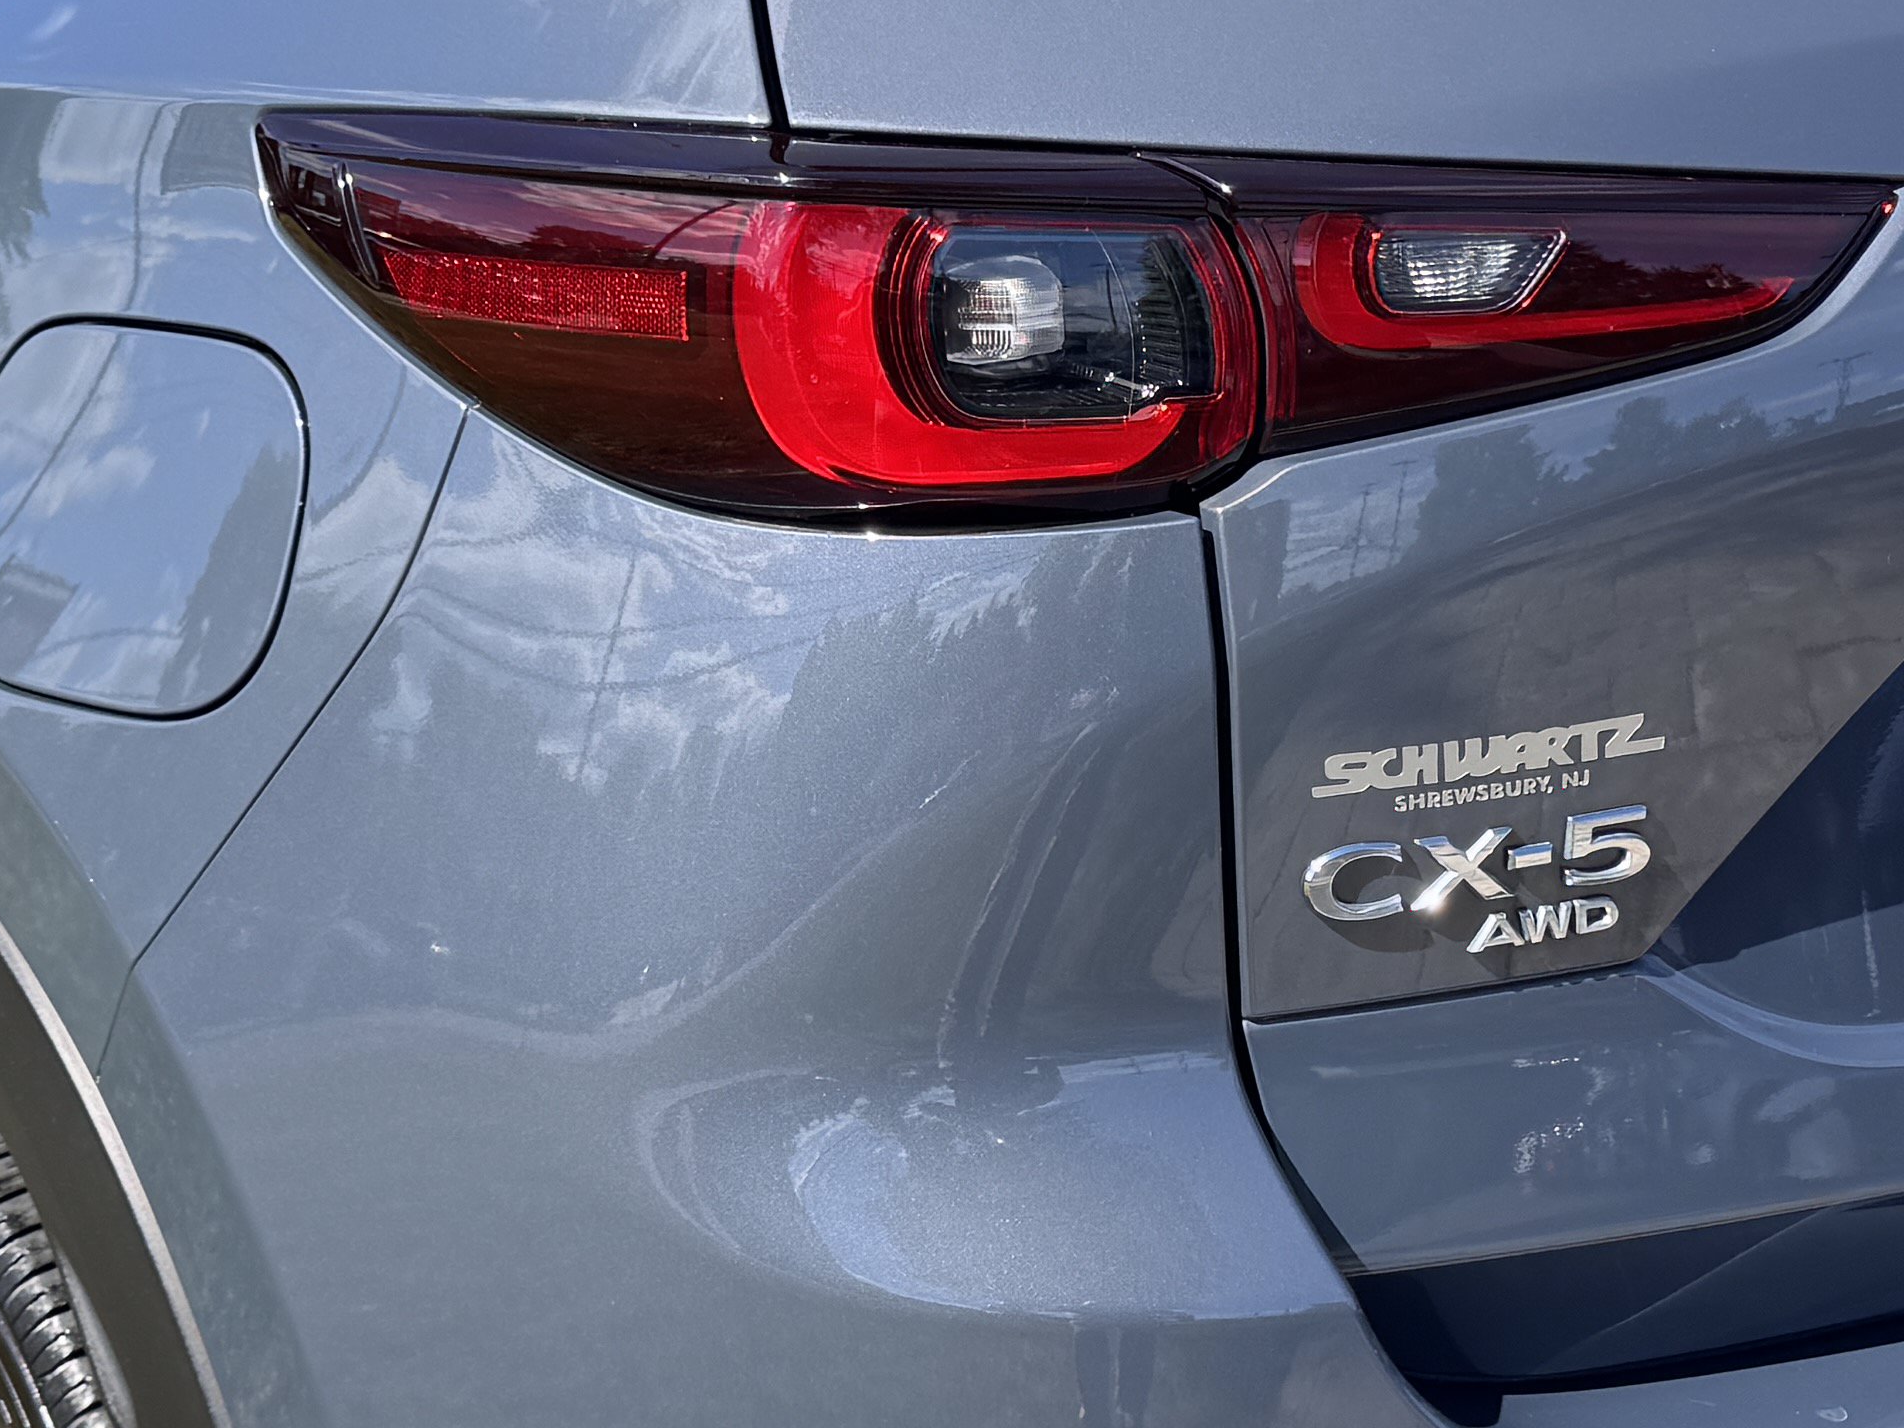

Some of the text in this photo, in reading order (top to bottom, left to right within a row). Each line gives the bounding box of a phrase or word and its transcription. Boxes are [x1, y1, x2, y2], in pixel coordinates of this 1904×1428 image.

[1311, 712, 1666, 799] SCHWARTZ
[1393, 769, 1591, 813] SHREWSBURY, NJ
[1302, 803, 1652, 922] CX-5
[1465, 895, 1621, 954] AWD
